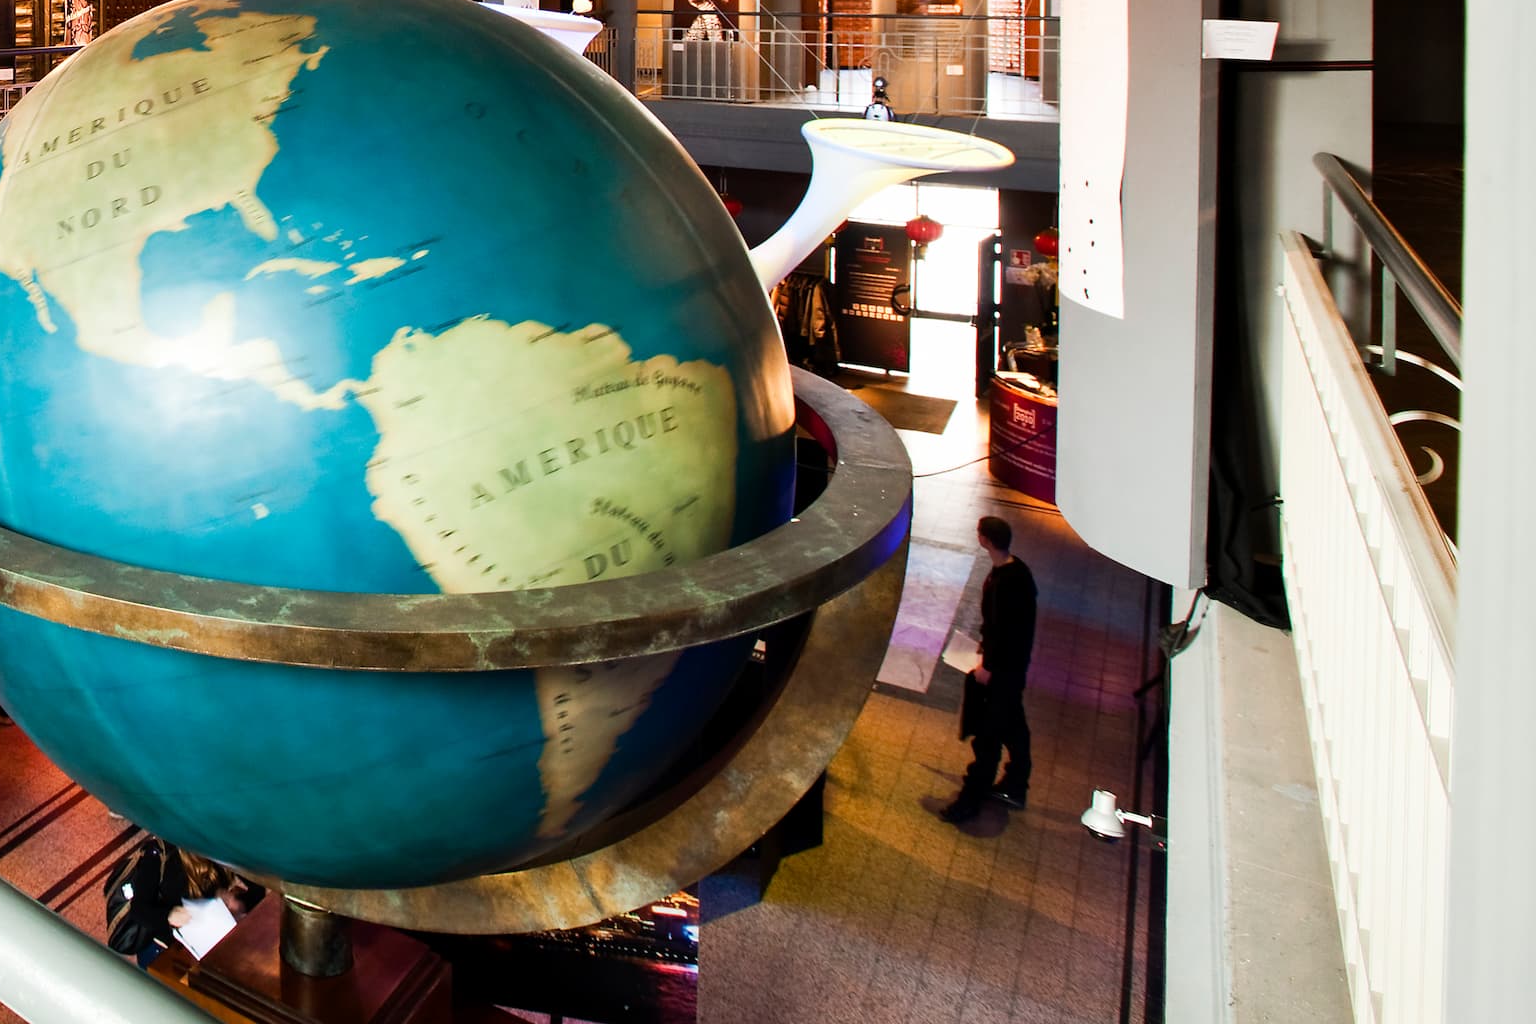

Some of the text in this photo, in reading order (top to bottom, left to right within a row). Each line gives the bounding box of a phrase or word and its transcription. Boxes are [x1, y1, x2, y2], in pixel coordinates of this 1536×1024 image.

[85, 147, 133, 181] DU
[55, 184, 163, 240] NORD
[469, 405, 680, 511] AMERIQUE
[582, 538, 634, 581] DU
